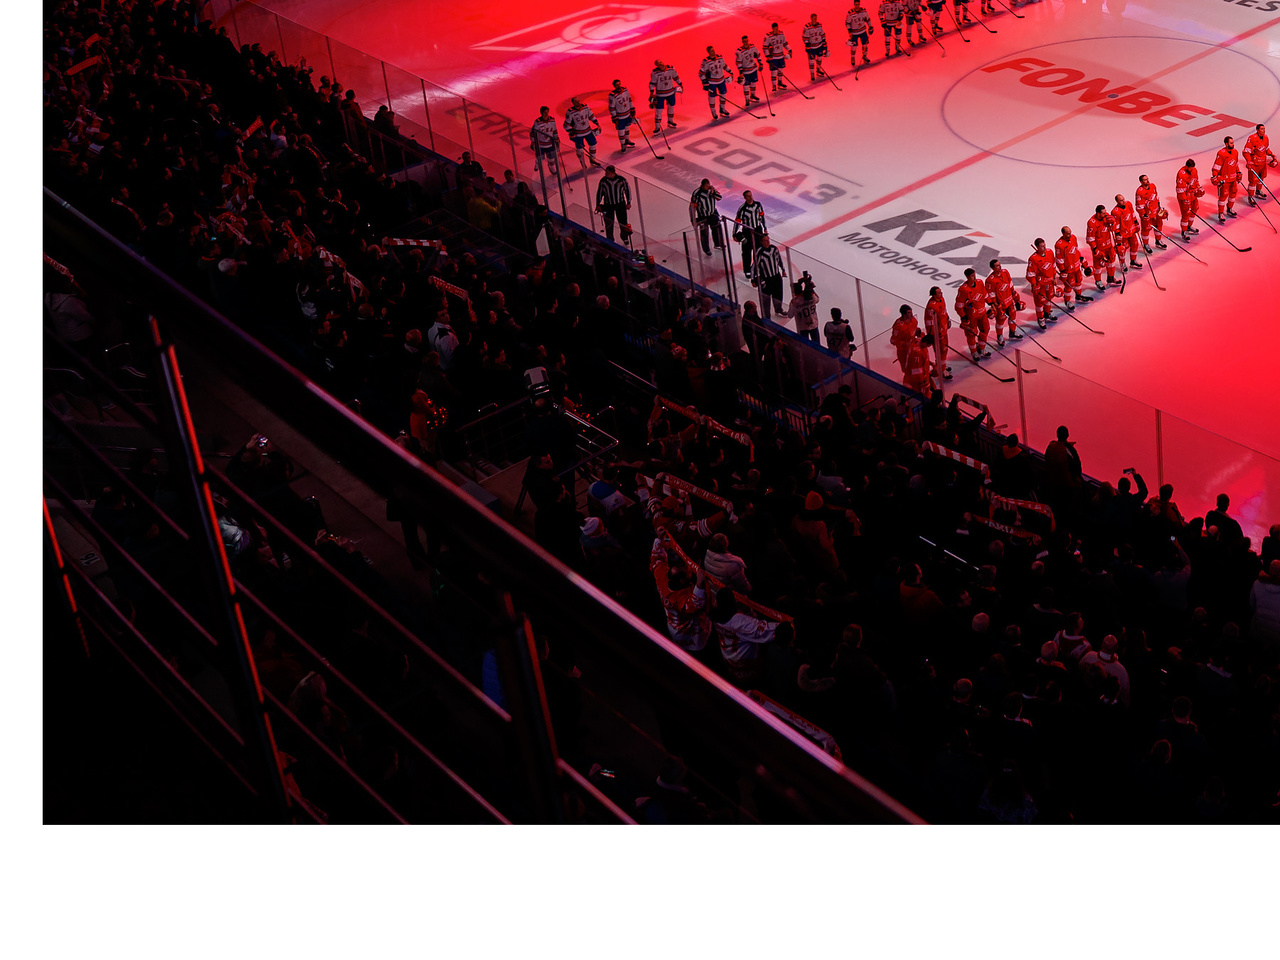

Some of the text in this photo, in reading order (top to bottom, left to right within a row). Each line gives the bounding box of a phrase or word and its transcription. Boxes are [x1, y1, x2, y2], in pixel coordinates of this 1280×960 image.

[981, 55, 1255, 137] FONBET
[683, 136, 848, 206] СОГАЗ
[837, 231, 952, 282] Моторное
